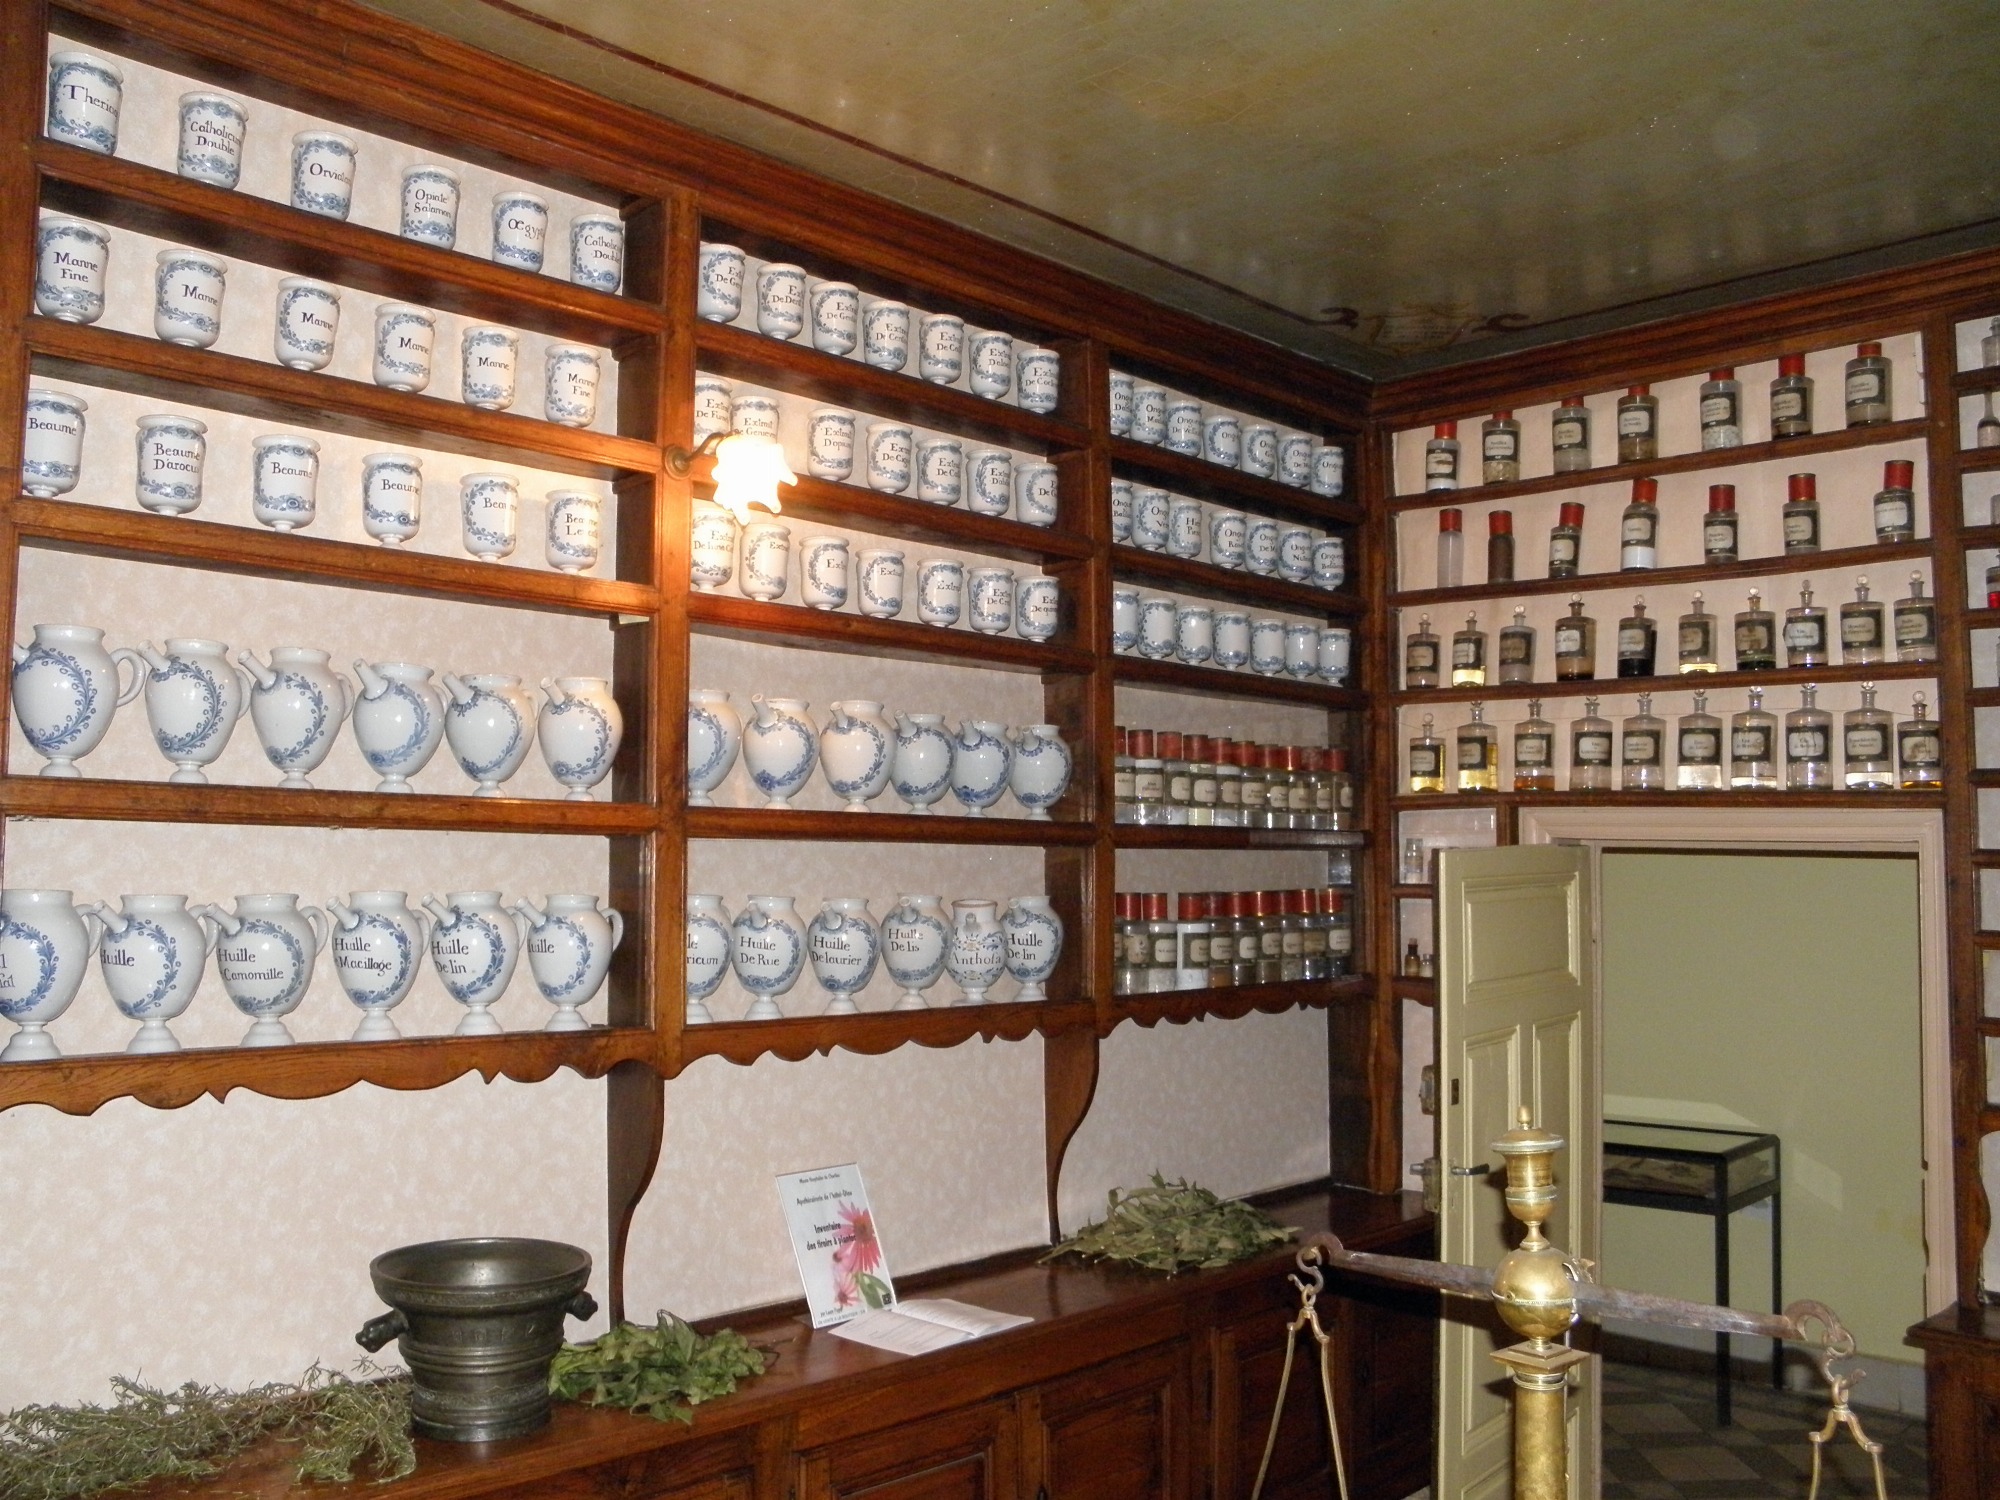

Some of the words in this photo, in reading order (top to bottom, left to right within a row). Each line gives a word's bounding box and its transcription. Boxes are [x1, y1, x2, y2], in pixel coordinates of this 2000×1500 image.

[195, 135, 235, 156] Double
[53, 251, 98, 272] Manne
[60, 267, 89, 284] Fine
[715, 273, 728, 284] De
[182, 284, 218, 307] Manne
[772, 294, 783, 303] De
[302, 312, 333, 332] Manne
[400, 336, 429, 356] Manne
[936, 343, 948, 351] De
[477, 356, 510, 372] Manne
[568, 372, 595, 388] Manne
[573, 385, 591, 399] Fine
[696, 410, 708, 418] De
[28, 417, 77, 437] Beaume
[153, 442, 201, 461] Beaume
[882, 452, 894, 461] De
[271, 461, 313, 479] Beaume
[937, 468, 948, 476] De
[381, 478, 421, 497] Beaume
[1039, 487, 1049, 496] De
[987, 597, 997, 605] De
[888, 928, 924, 940] Huille
[334, 937, 371, 952] Huille
[432, 939, 469, 955] Huille
[740, 936, 776, 951] Huille
[813, 935, 851, 951] Huille
[218, 948, 256, 962] Huille
[740, 953, 755, 964] De
[758, 954, 780, 966] Rue
[224, 968, 284, 981] Camomille
[814, 1221, 841, 1234] Inventaire
[806, 1241, 817, 1251] des
